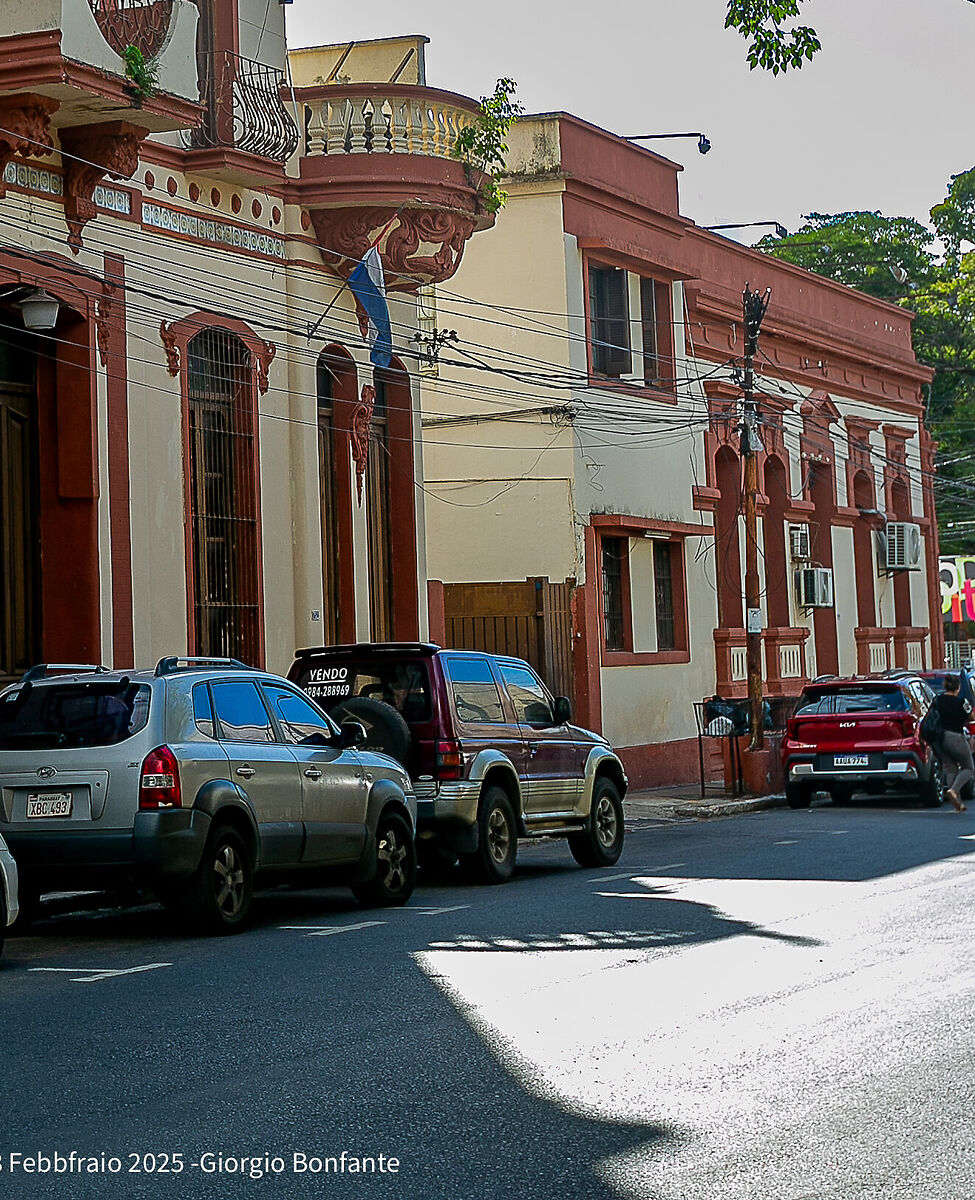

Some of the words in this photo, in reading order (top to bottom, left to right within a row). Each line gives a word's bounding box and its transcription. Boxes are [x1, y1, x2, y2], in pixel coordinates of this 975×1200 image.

[310, 667, 348, 681] VENDO
[31, 802, 48, 815] XBC
[51, 801, 68, 814] 493
